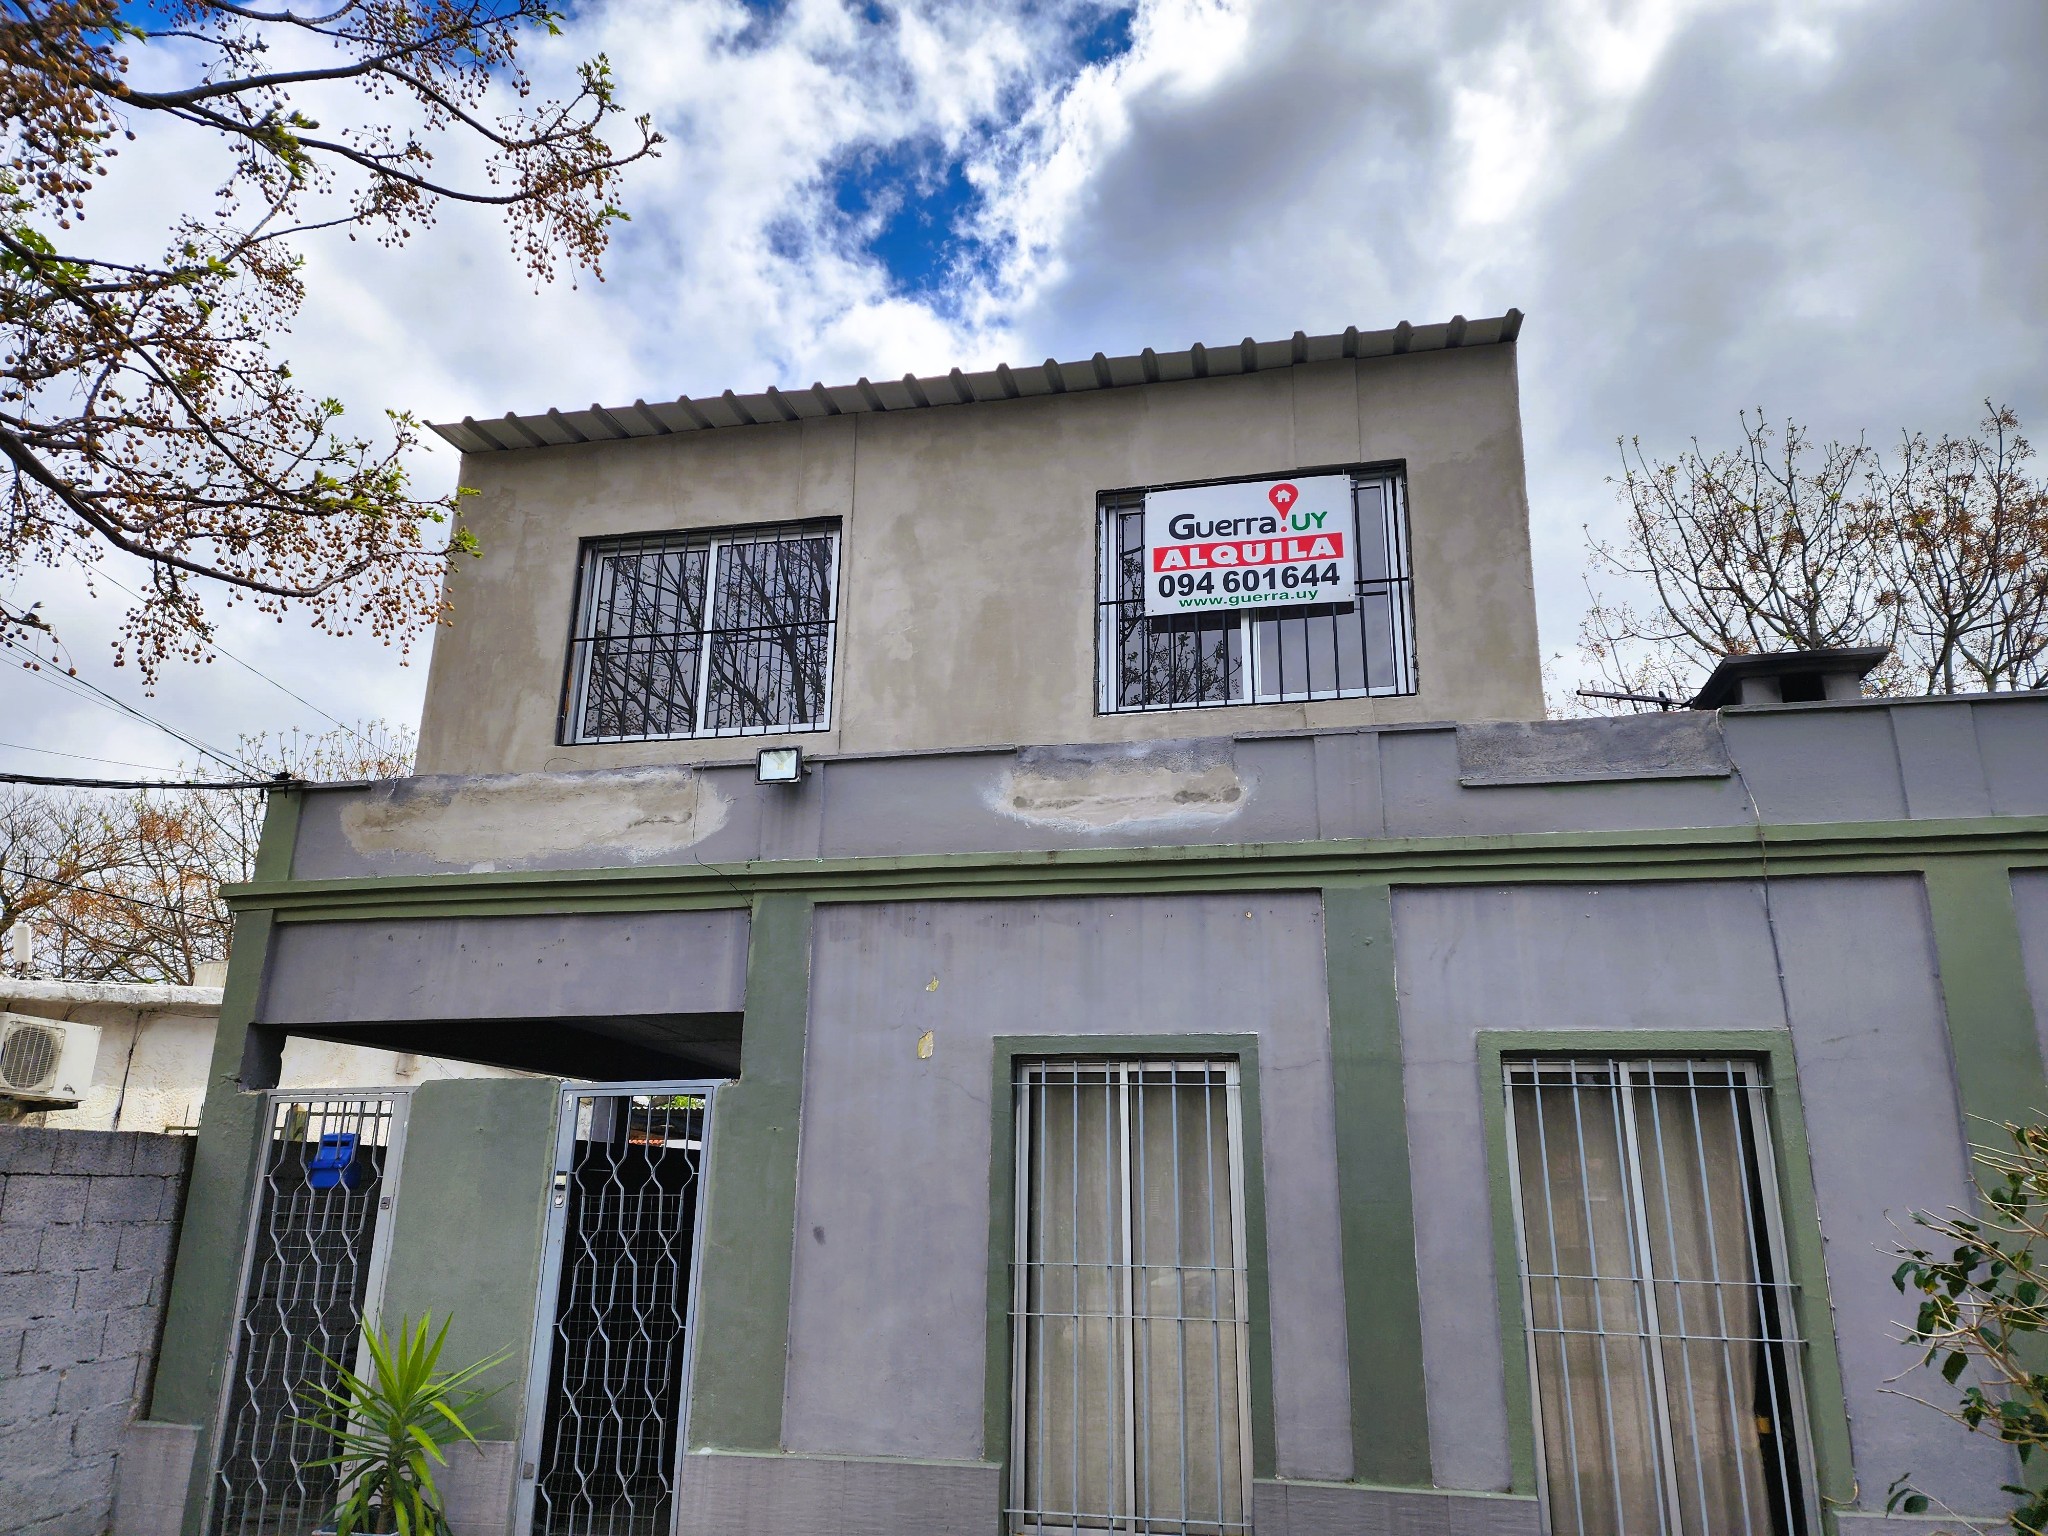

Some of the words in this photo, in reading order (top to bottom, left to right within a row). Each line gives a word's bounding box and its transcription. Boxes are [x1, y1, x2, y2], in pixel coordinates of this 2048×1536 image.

[1160, 536, 1337, 569] ALQUILA
[1158, 571, 1215, 598] 094
[1222, 562, 1341, 593] 601644
[1178, 589, 1319, 608] www.guerra.uy
